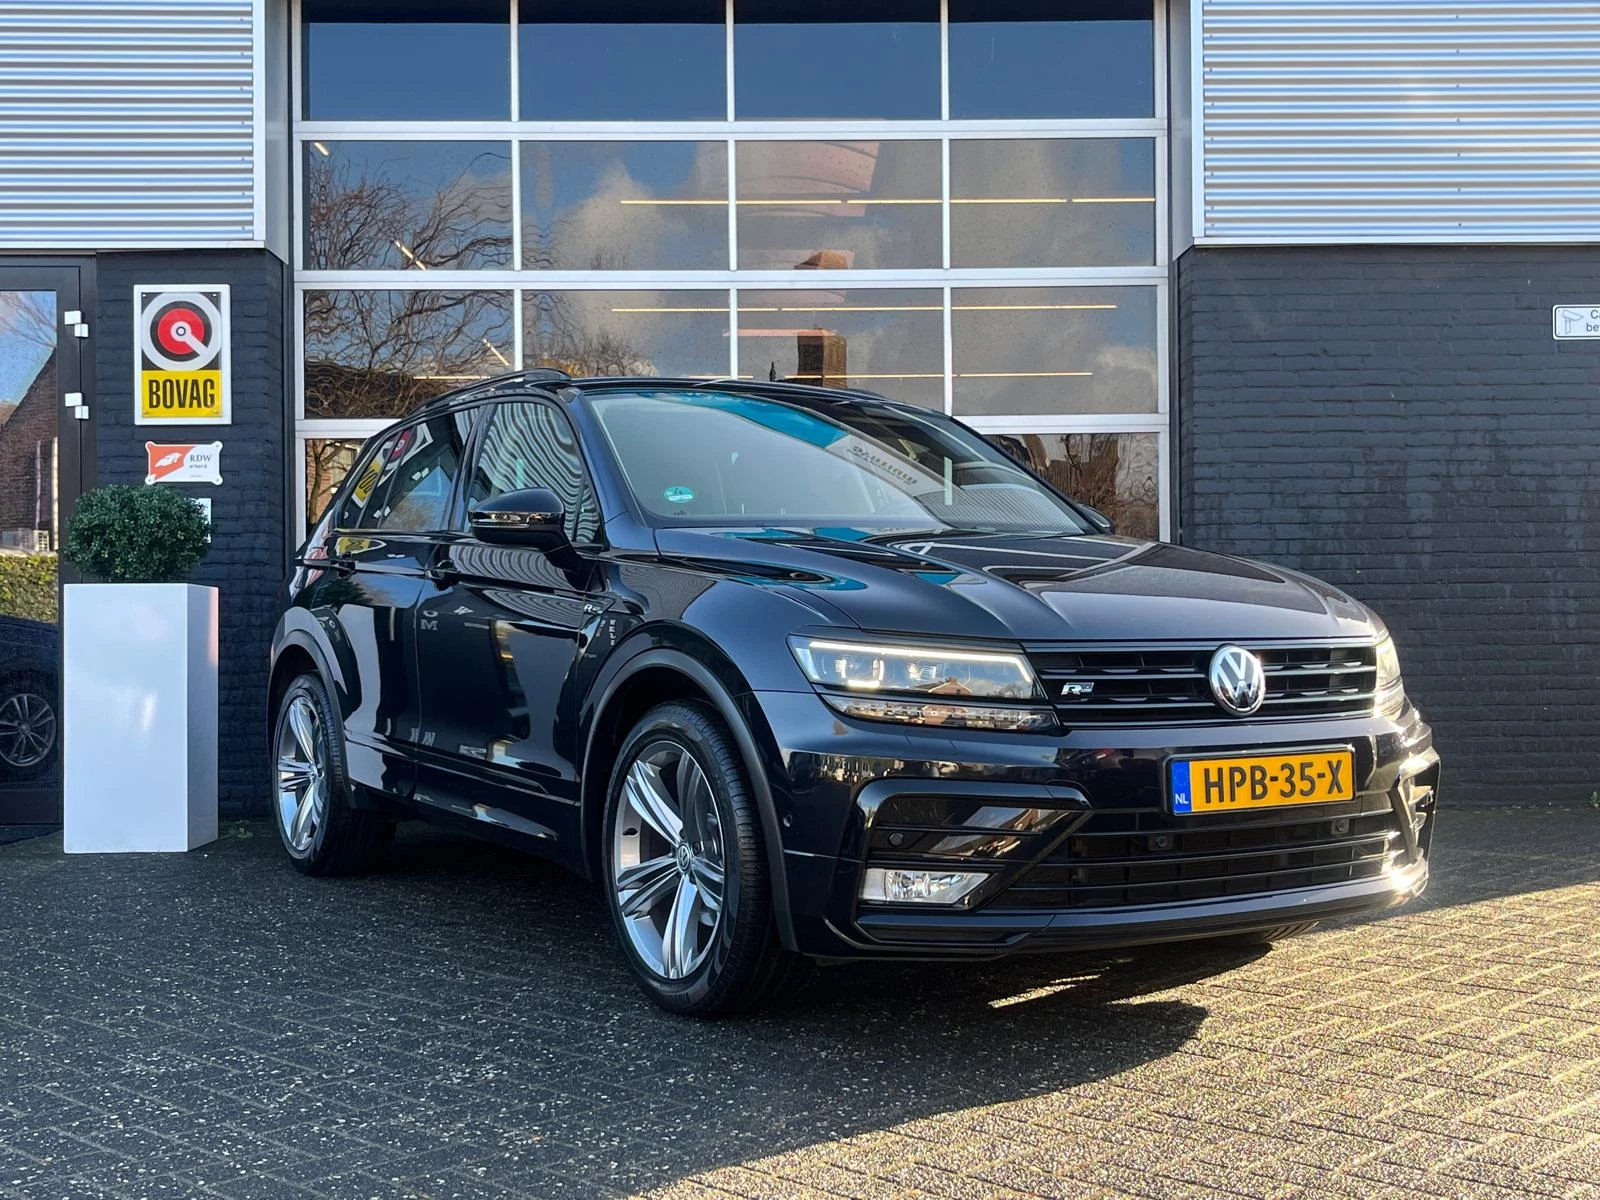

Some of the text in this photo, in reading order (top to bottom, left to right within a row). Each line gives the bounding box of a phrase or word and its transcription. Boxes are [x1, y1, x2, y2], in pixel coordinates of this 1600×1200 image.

[148, 378, 216, 409] BOVAG
[190, 454, 212, 462] RDW
[1204, 760, 1343, 804] HPB-35-X
[1175, 793, 1189, 805] NL
